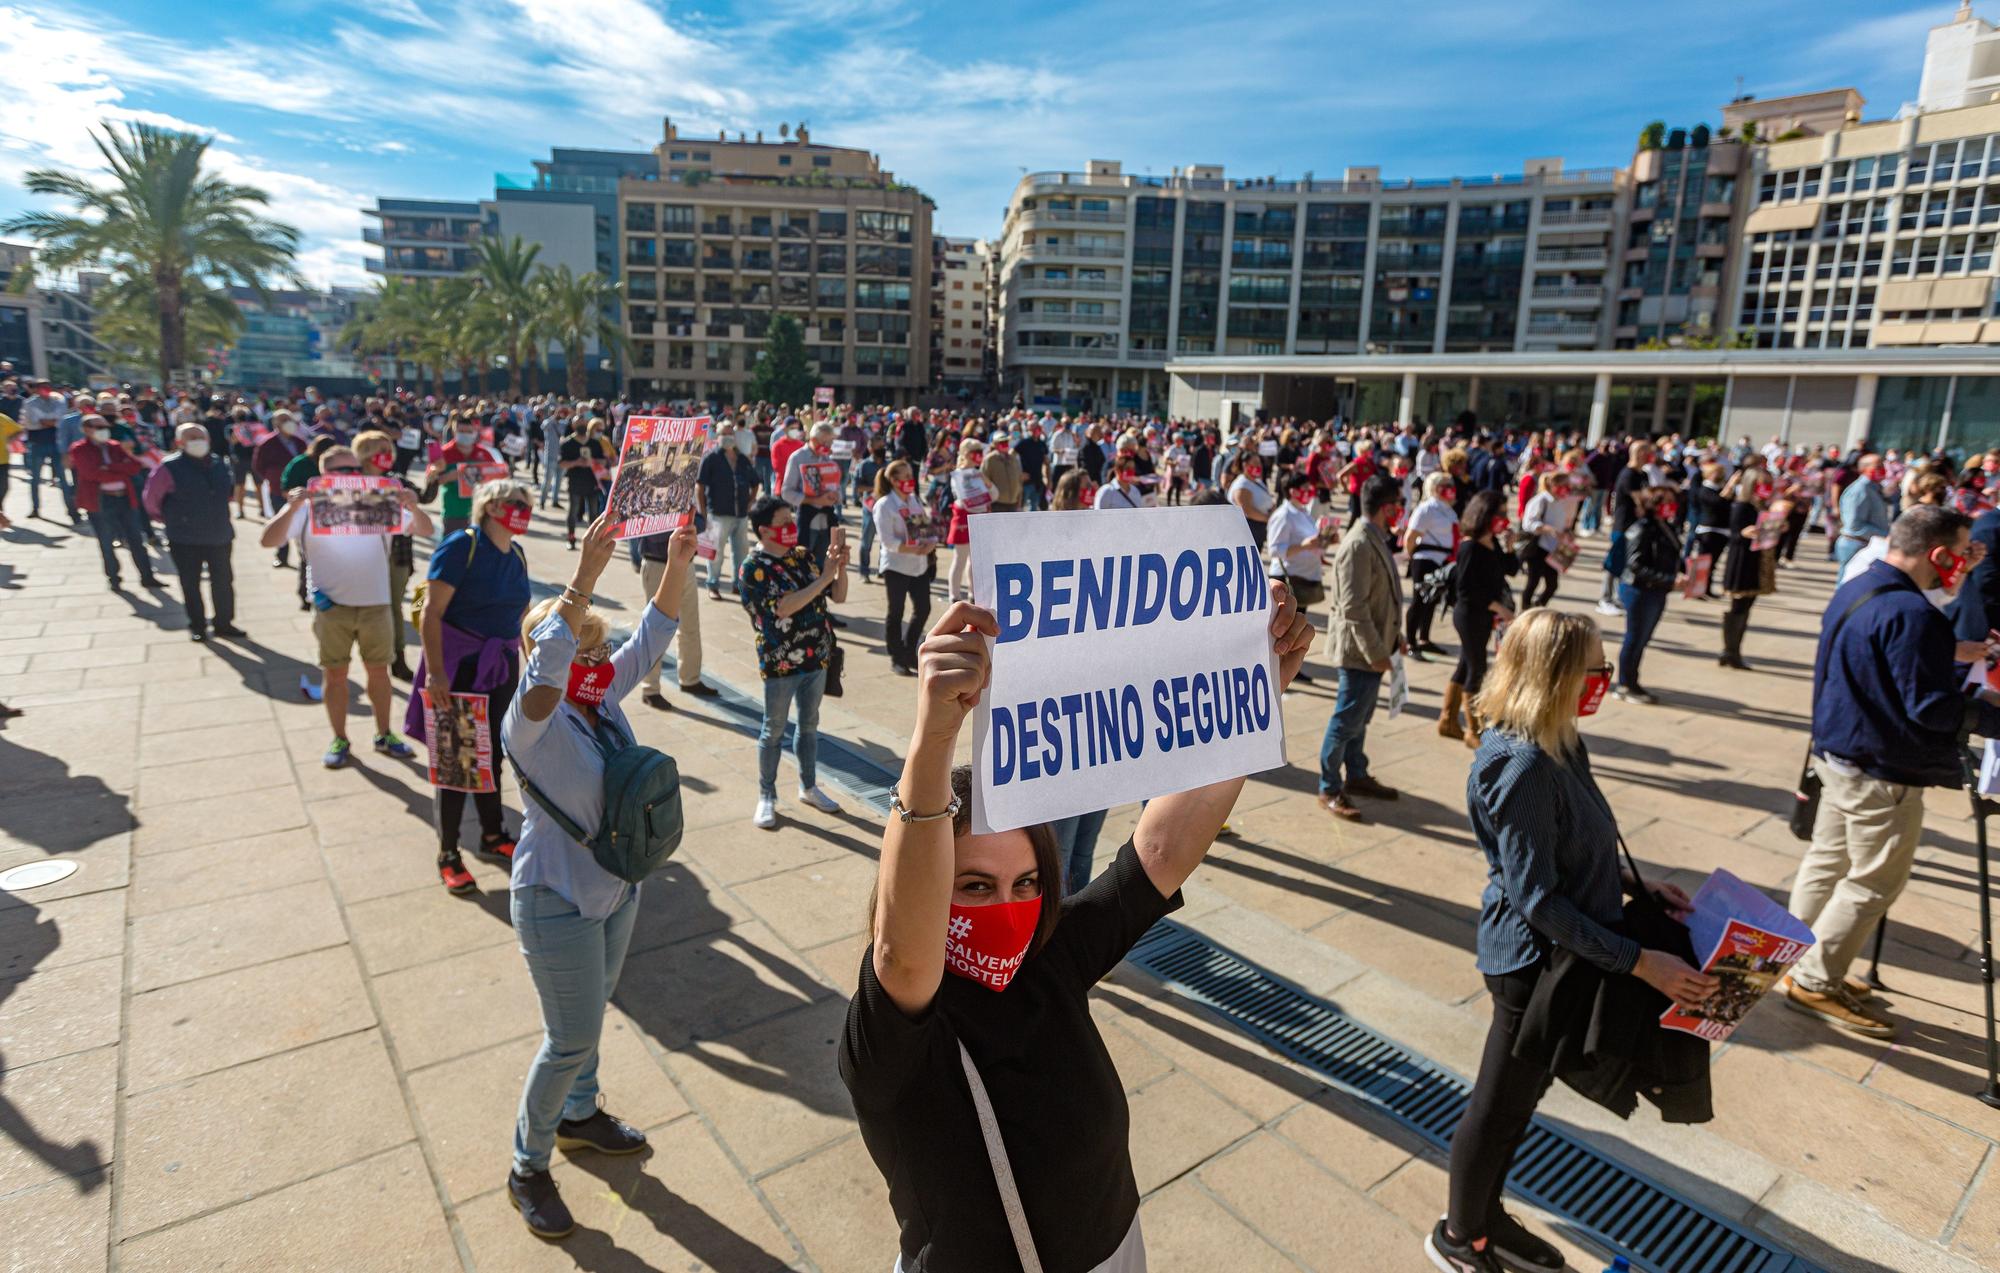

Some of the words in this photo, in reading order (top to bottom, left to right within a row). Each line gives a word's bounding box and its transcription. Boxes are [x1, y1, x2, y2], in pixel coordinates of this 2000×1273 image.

[994, 545, 1267, 645] BENIDORM
[991, 684, 1144, 786] DESTINO
[1152, 663, 1271, 752] SEGURO
